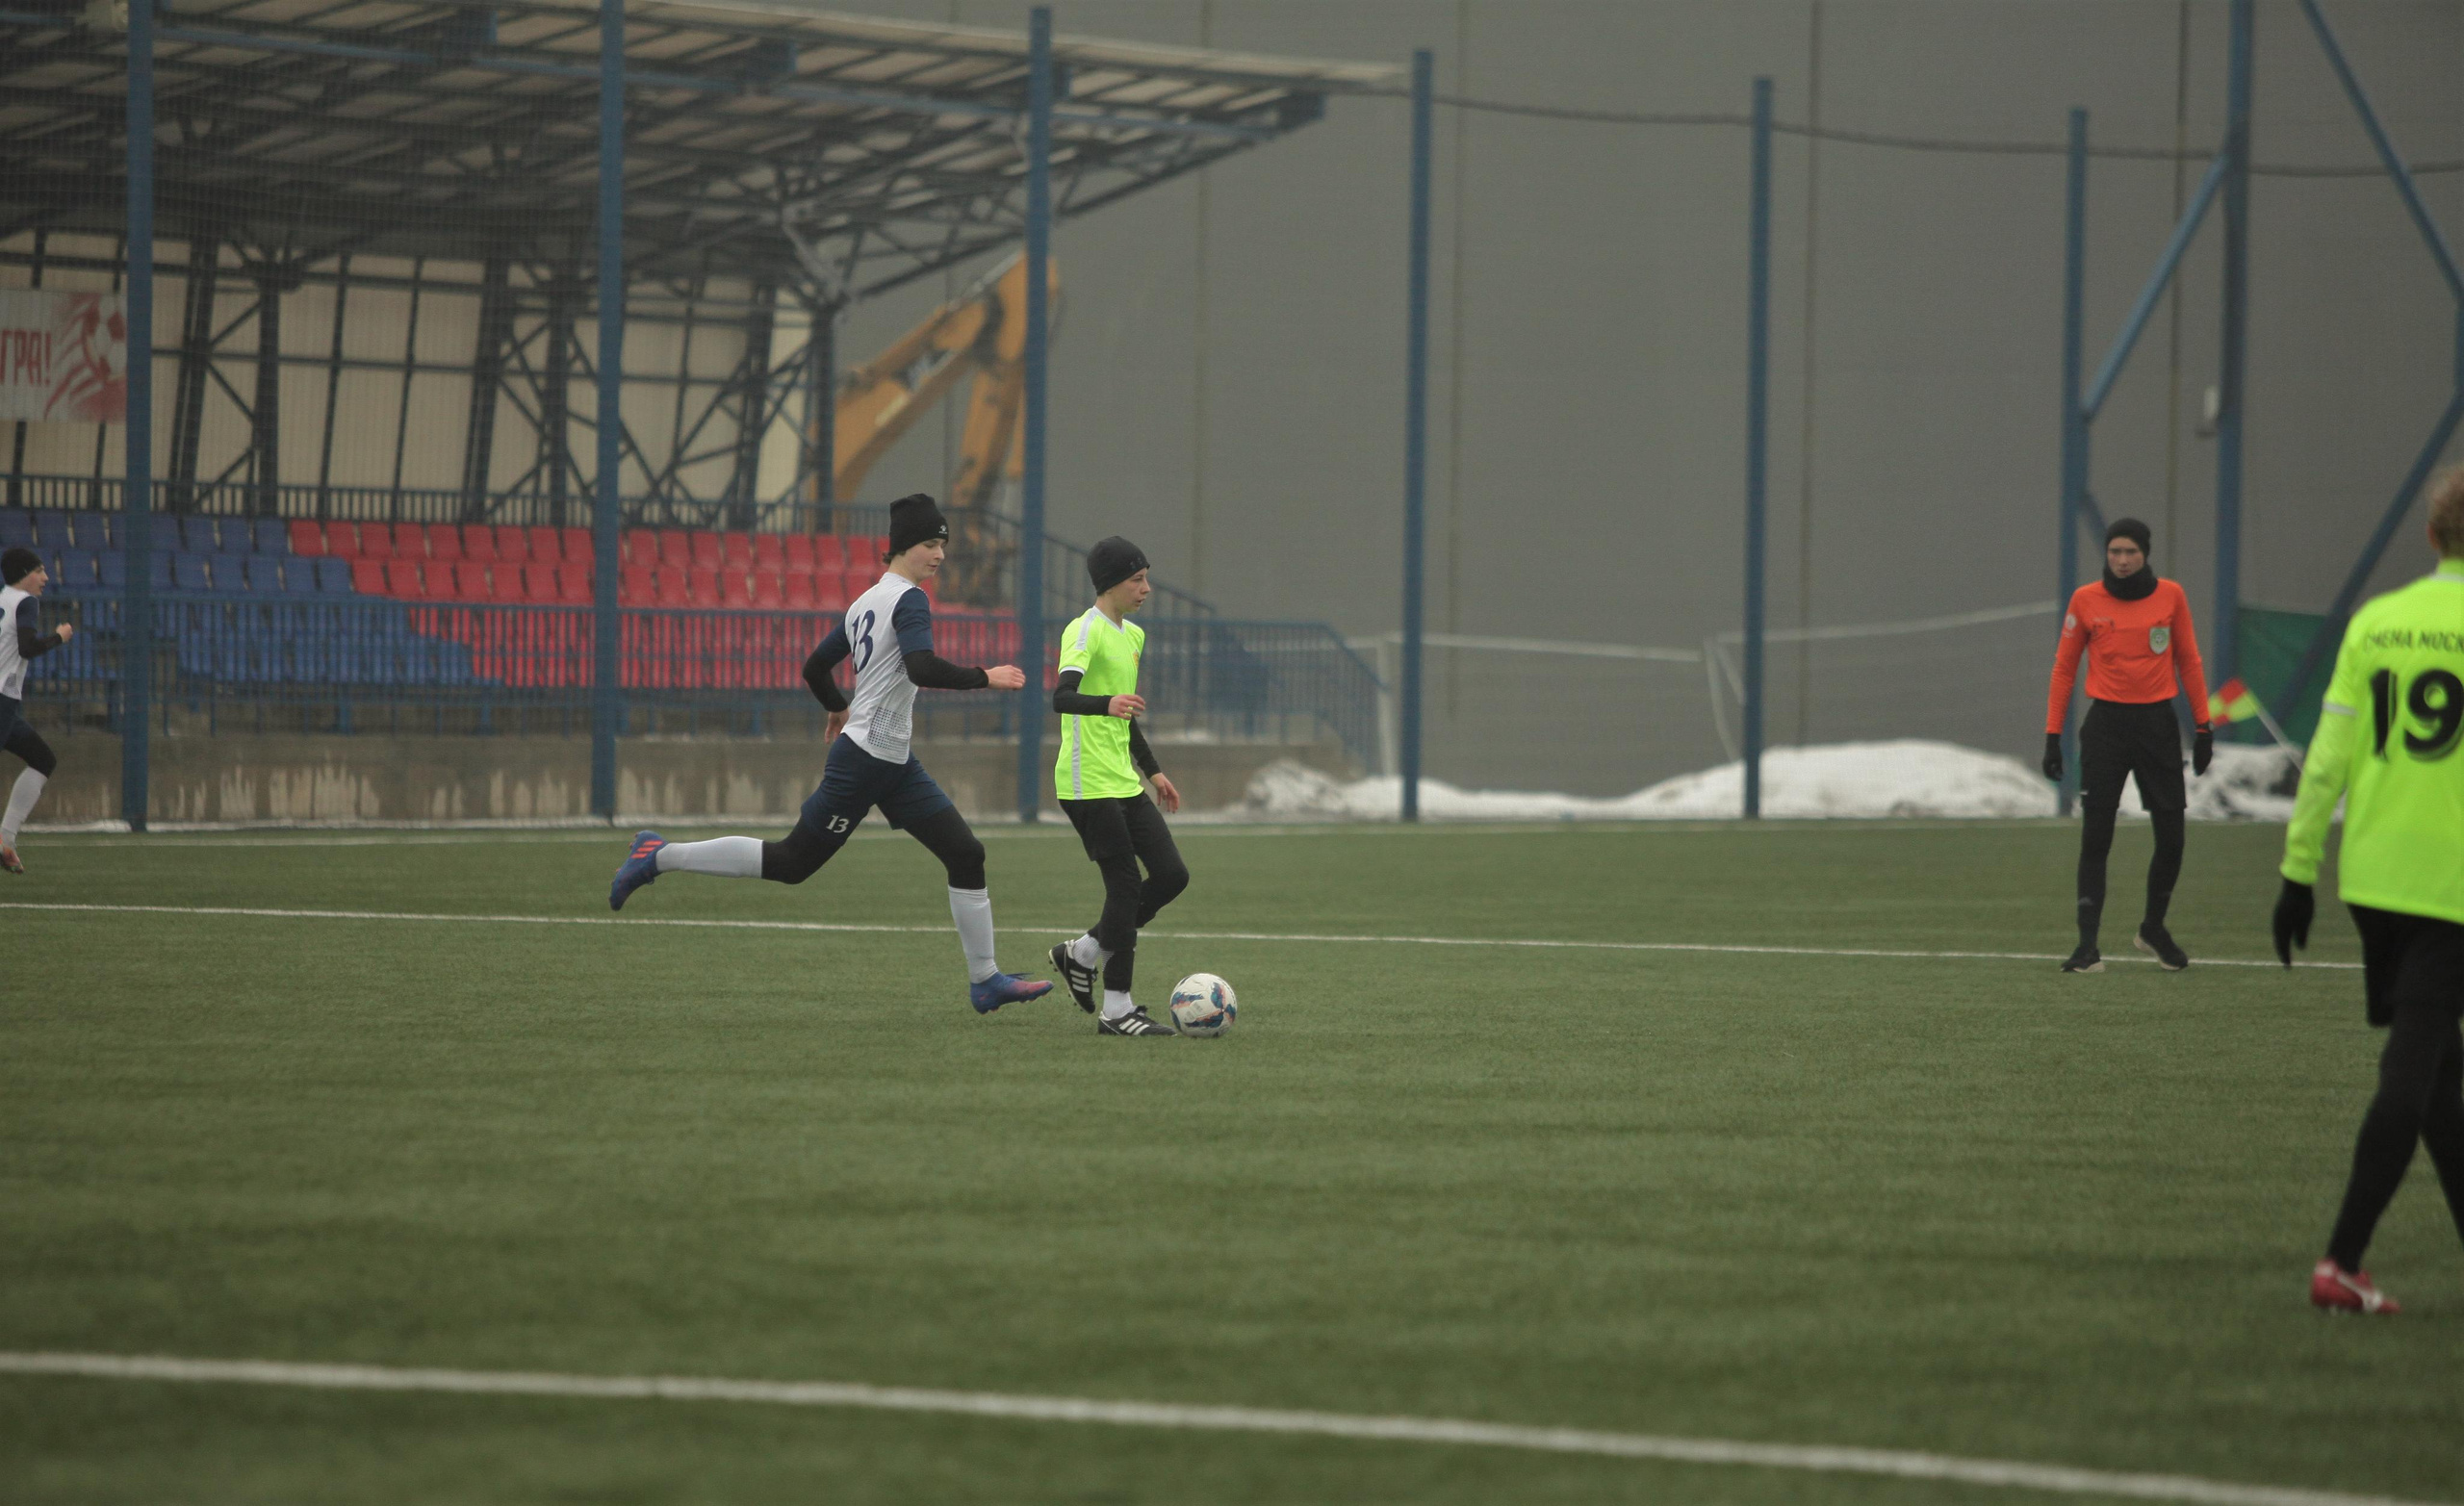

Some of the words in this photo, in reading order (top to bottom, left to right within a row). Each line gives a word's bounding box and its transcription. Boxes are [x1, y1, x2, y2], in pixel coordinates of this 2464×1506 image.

[852, 609, 875, 675] 13
[2370, 668, 2464, 761] 19
[826, 815, 849, 833] 13
